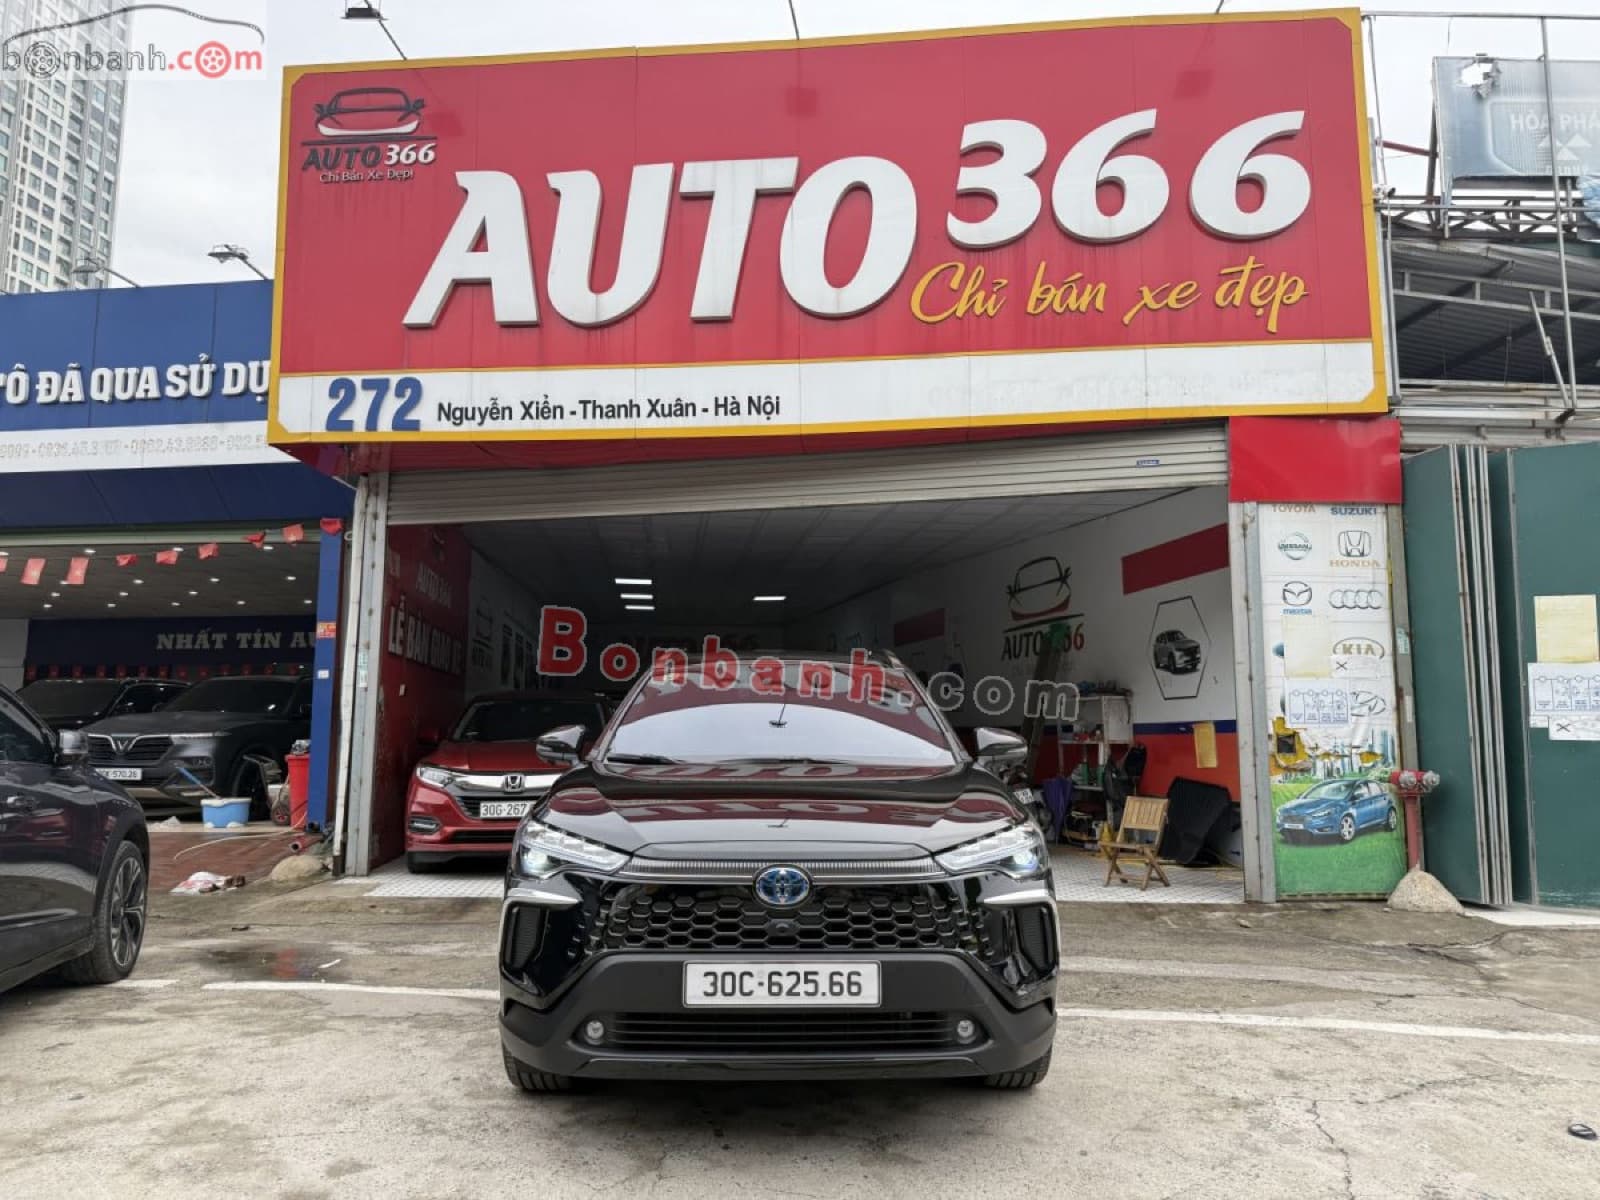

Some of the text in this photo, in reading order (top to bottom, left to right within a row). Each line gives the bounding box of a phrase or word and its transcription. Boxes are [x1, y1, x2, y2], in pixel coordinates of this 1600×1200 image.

[302, 142, 437, 171] AUTO 366
[403, 108, 1311, 329] AUTO 366
[910, 255, 1308, 333] Chỉ bán xe đẹp
[0, 363, 30, 405] Ô
[36, 362, 86, 405] ĐÃ
[90, 366, 162, 404] QUA
[165, 353, 217, 399] SỬ
[325, 376, 423, 432] 272
[437, 396, 513, 427] Nguyễn
[520, 393, 565, 420] Xiển
[646, 397, 697, 419] Xuân
[714, 396, 742, 417] Hà
[747, 395, 781, 421] Nội
[1272, 504, 1377, 516] TOYOTA SUZUKI
[1330, 560, 1380, 568] HONDA
[156, 626, 228, 650] NHẤT
[1342, 643, 1376, 655] KIA
[702, 970, 863, 998] 30C-625.66
